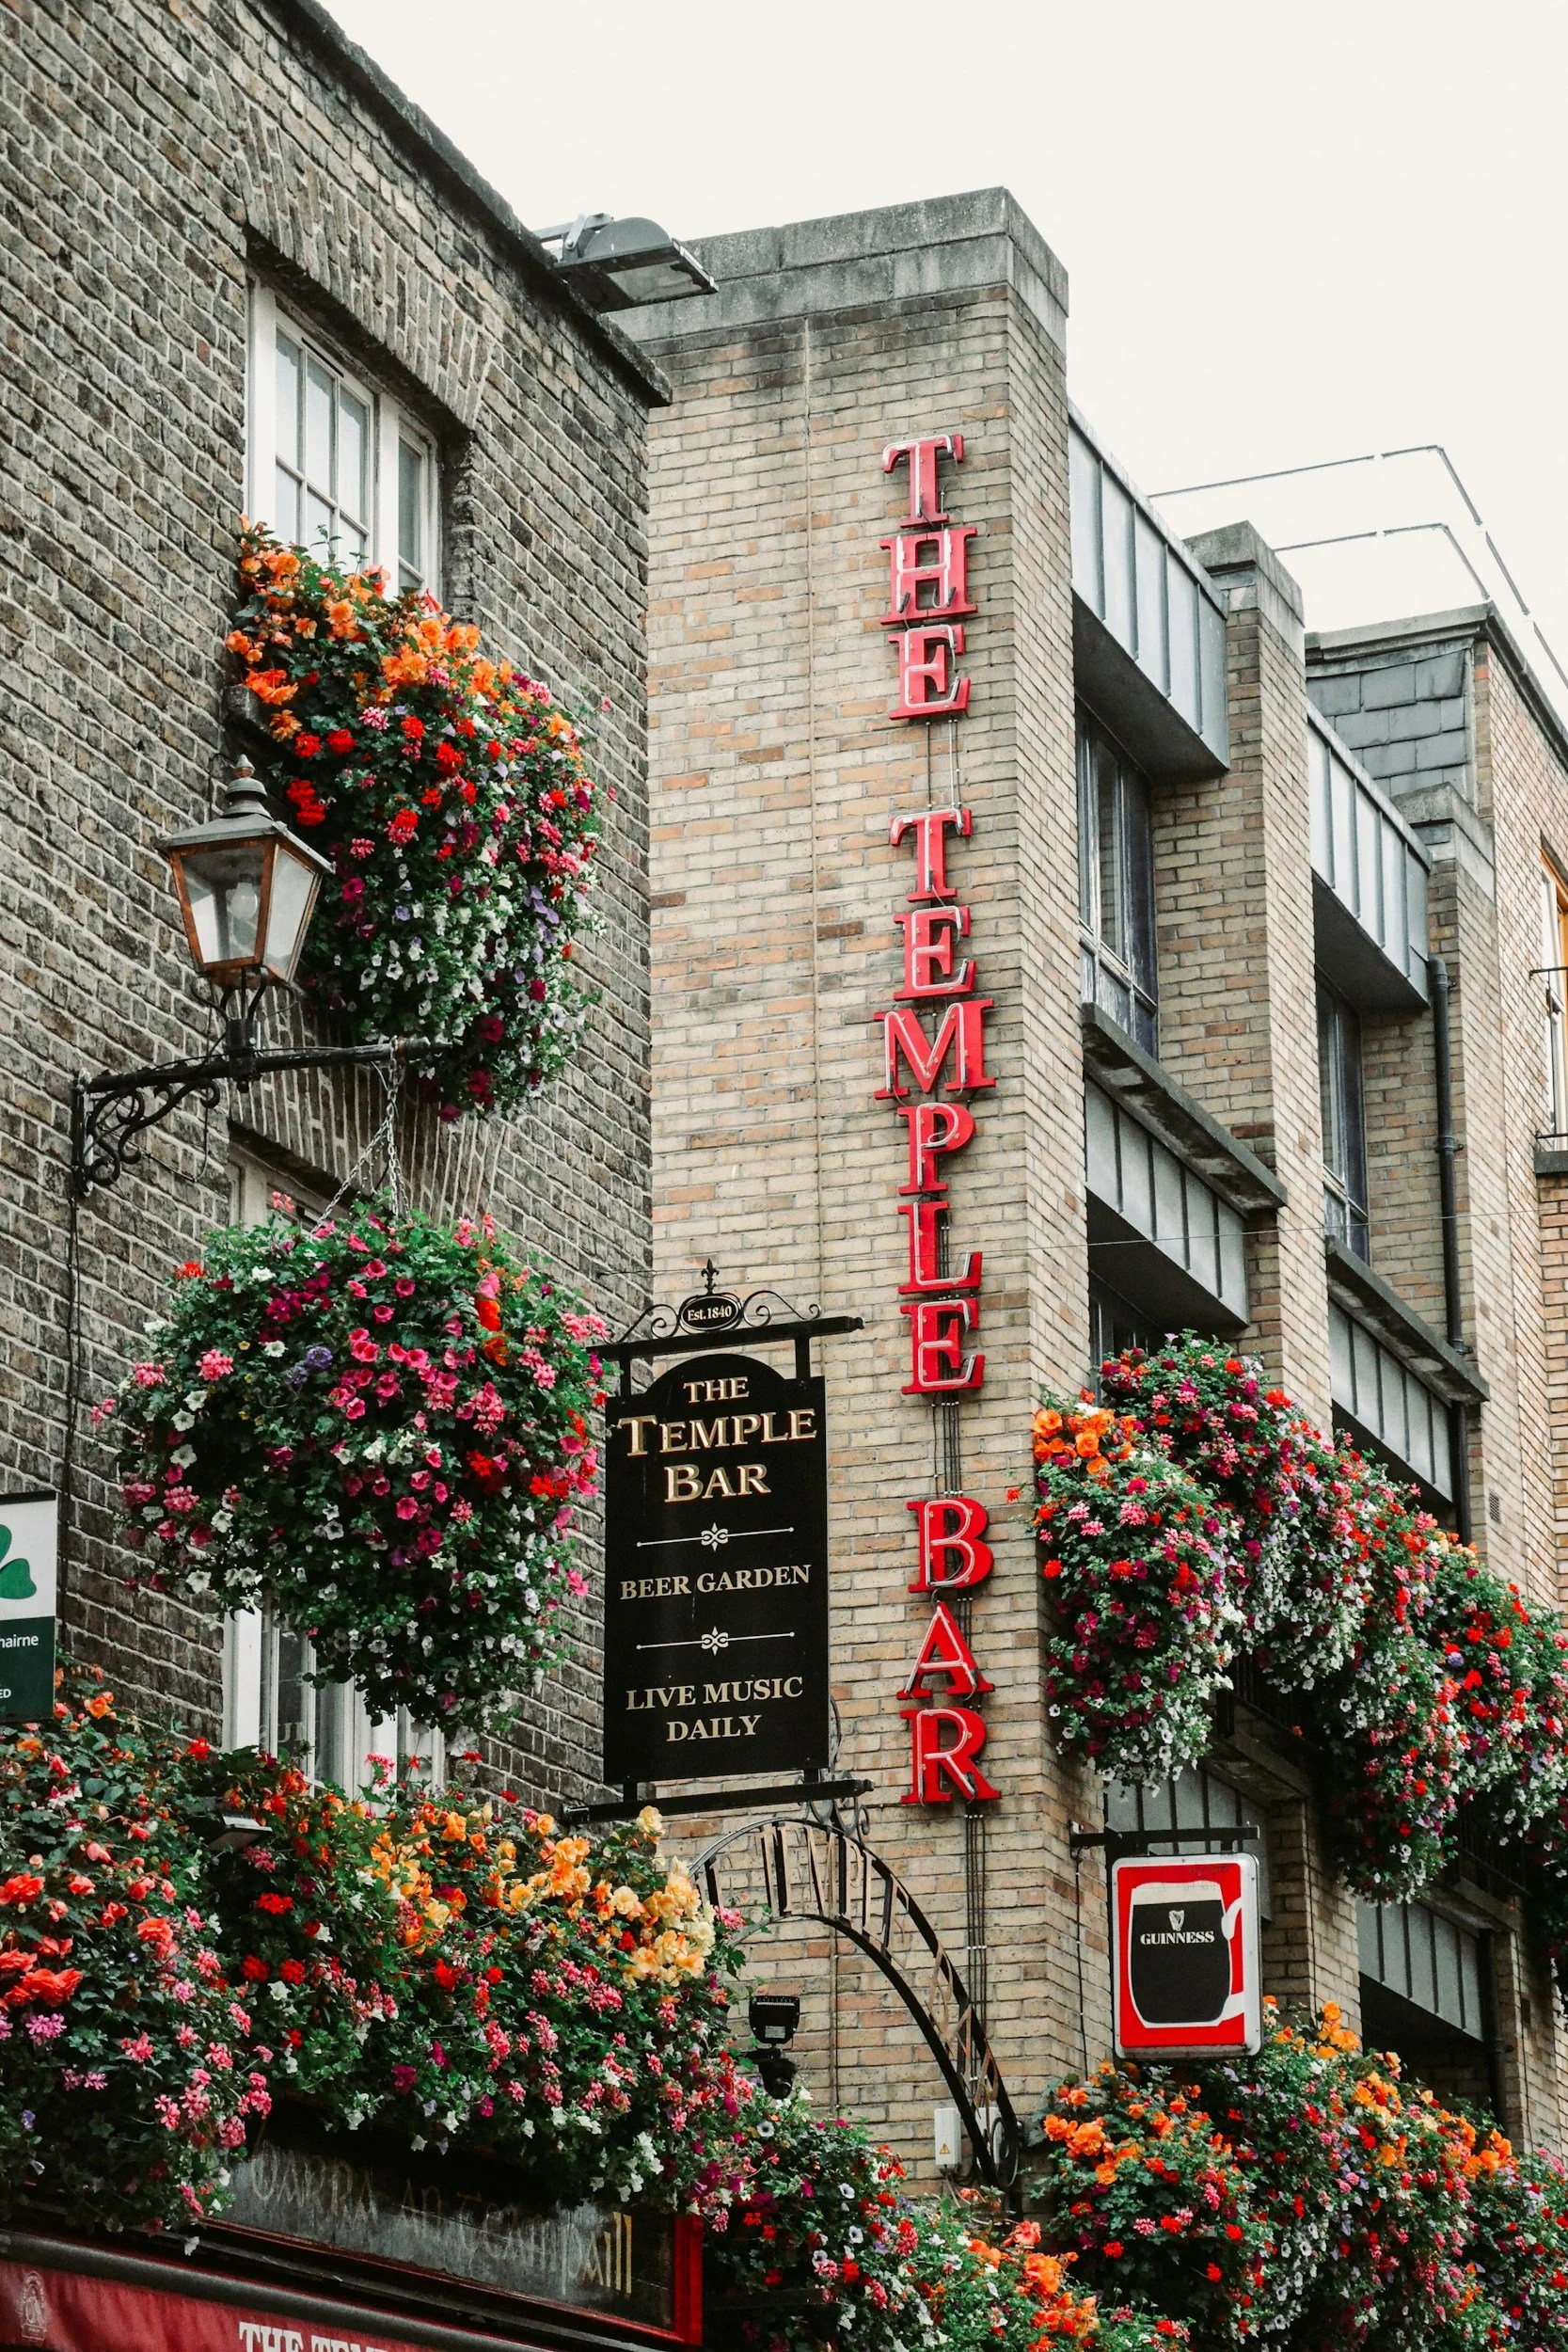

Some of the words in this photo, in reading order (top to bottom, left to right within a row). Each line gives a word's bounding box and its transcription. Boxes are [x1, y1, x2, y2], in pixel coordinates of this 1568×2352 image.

[880, 434, 979, 721] THE
[873, 808, 997, 1394] TEMPLE
[683, 1376, 750, 1404] THE
[617, 1408, 817, 1456] TEMPLE
[664, 1463, 771, 1502] BAR
[620, 1575, 692, 1600] BEER
[696, 1565, 812, 1594] GARDEN
[896, 1497, 1001, 1805] BAR
[626, 1685, 697, 1710] LIVE
[703, 1677, 803, 1705] MUSIC
[666, 1714, 762, 1742] DAILY
[1140, 1931, 1214, 1946] GUINNESS
